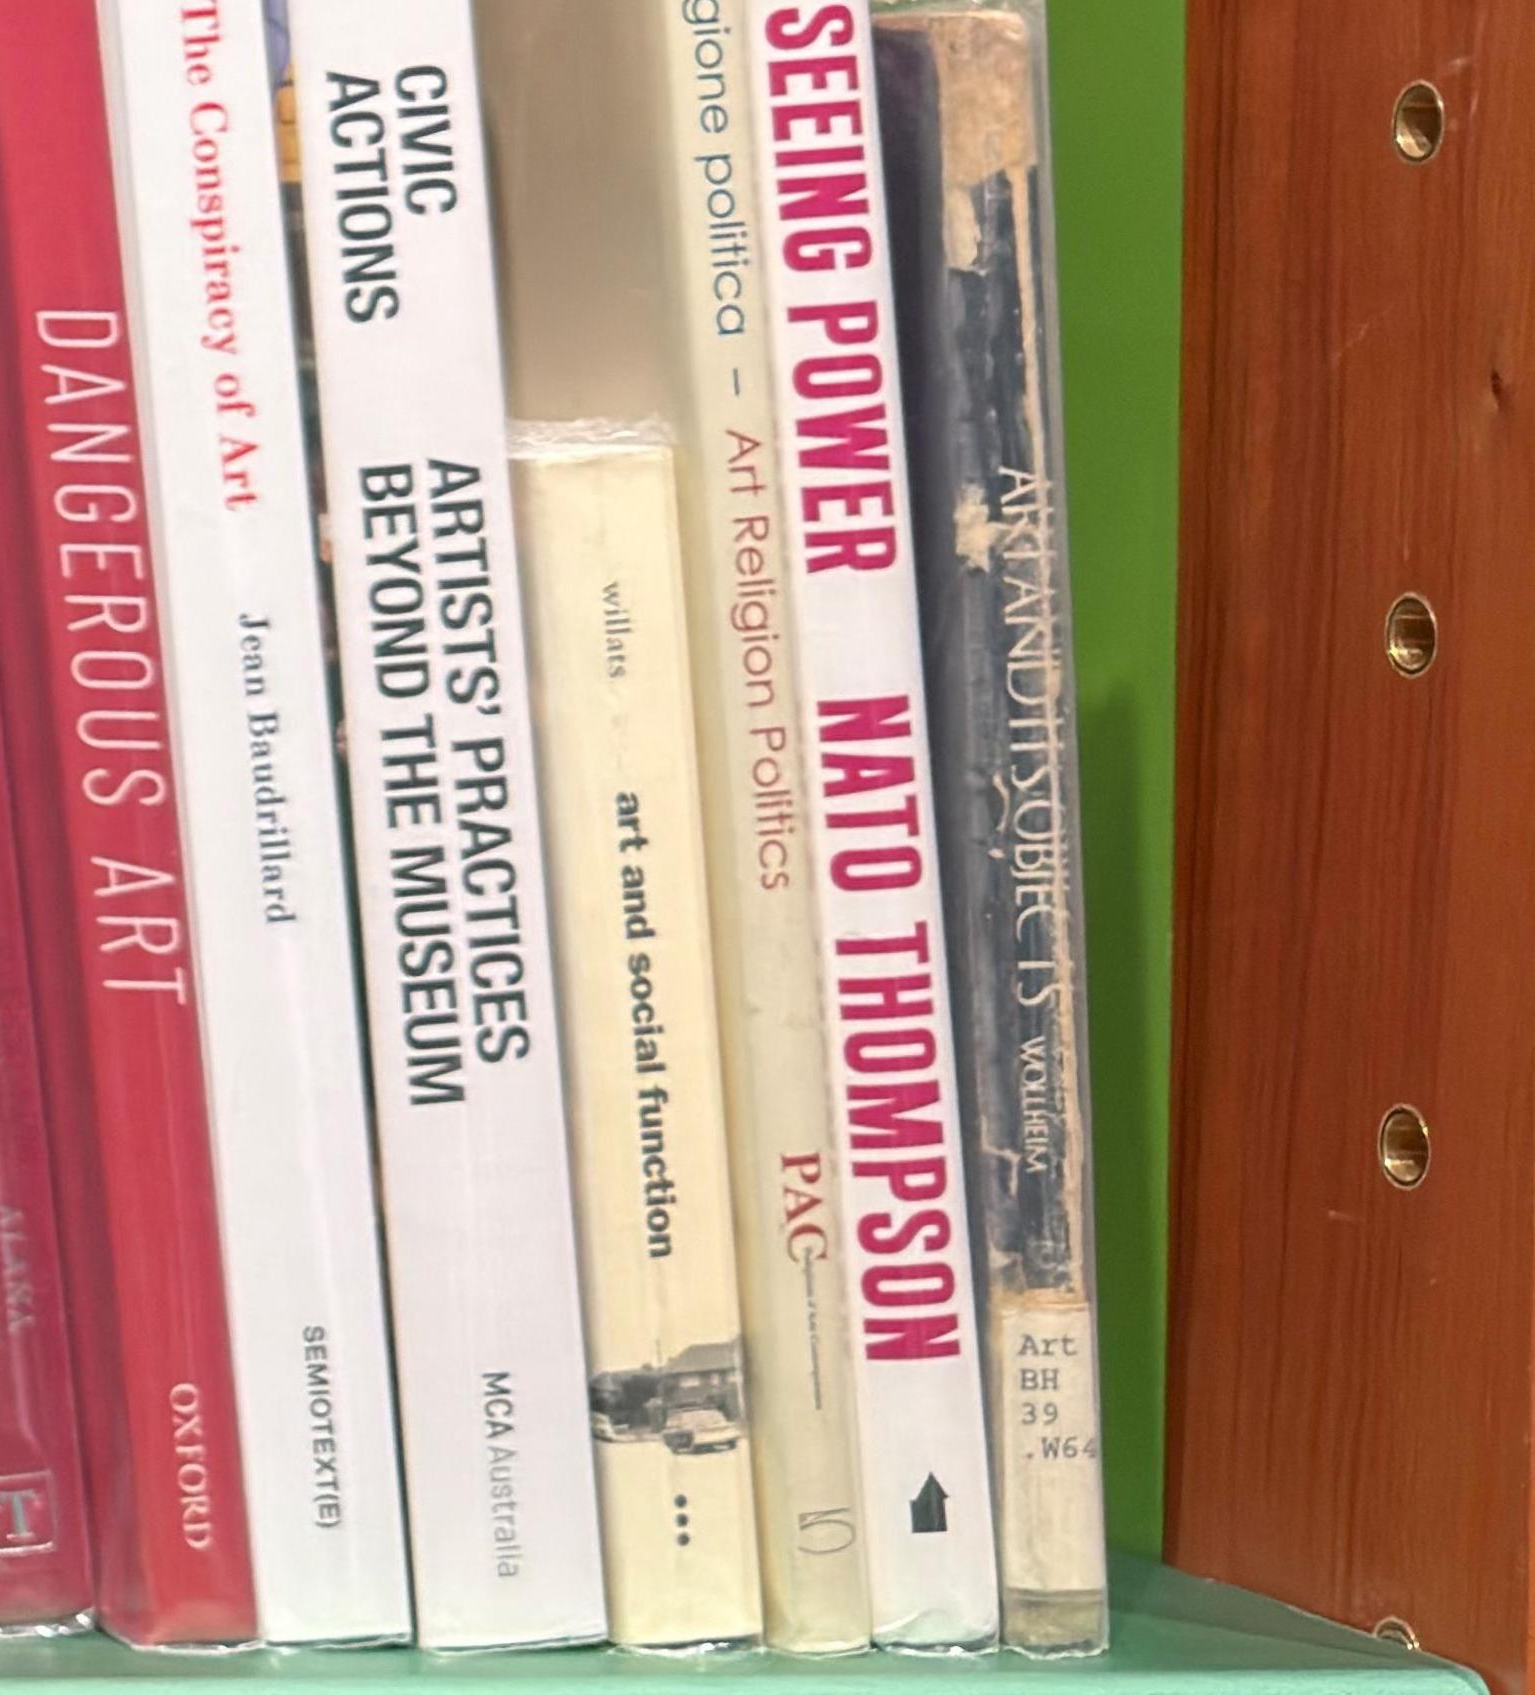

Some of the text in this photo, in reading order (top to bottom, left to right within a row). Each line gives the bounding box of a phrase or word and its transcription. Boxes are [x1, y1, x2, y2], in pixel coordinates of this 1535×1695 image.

[764, 5, 898, 577] SEEING POWER
[36, 310, 189, 1007] DANGEROUS ART
[237, 612, 296, 925] Jean Baudrillard
[360, 464, 467, 1107] BEYOND THE MUSEUM
[450, 739, 530, 1066] PRACTICES
[616, 790, 675, 1260] art and social function
[817, 694, 962, 1363] NATO THOMPSON
[167, 1381, 214, 1550] OXFORD
[303, 1324, 340, 1529] SEMIOTEXT(E)
[483, 1371, 518, 1581] MCA Australia
[1020, 1334, 1078, 1358] Art
[1020, 1370, 1059, 1392] BH
[1020, 1402, 1059, 1426] 39
[1025, 1436, 1098, 1462] .W64
